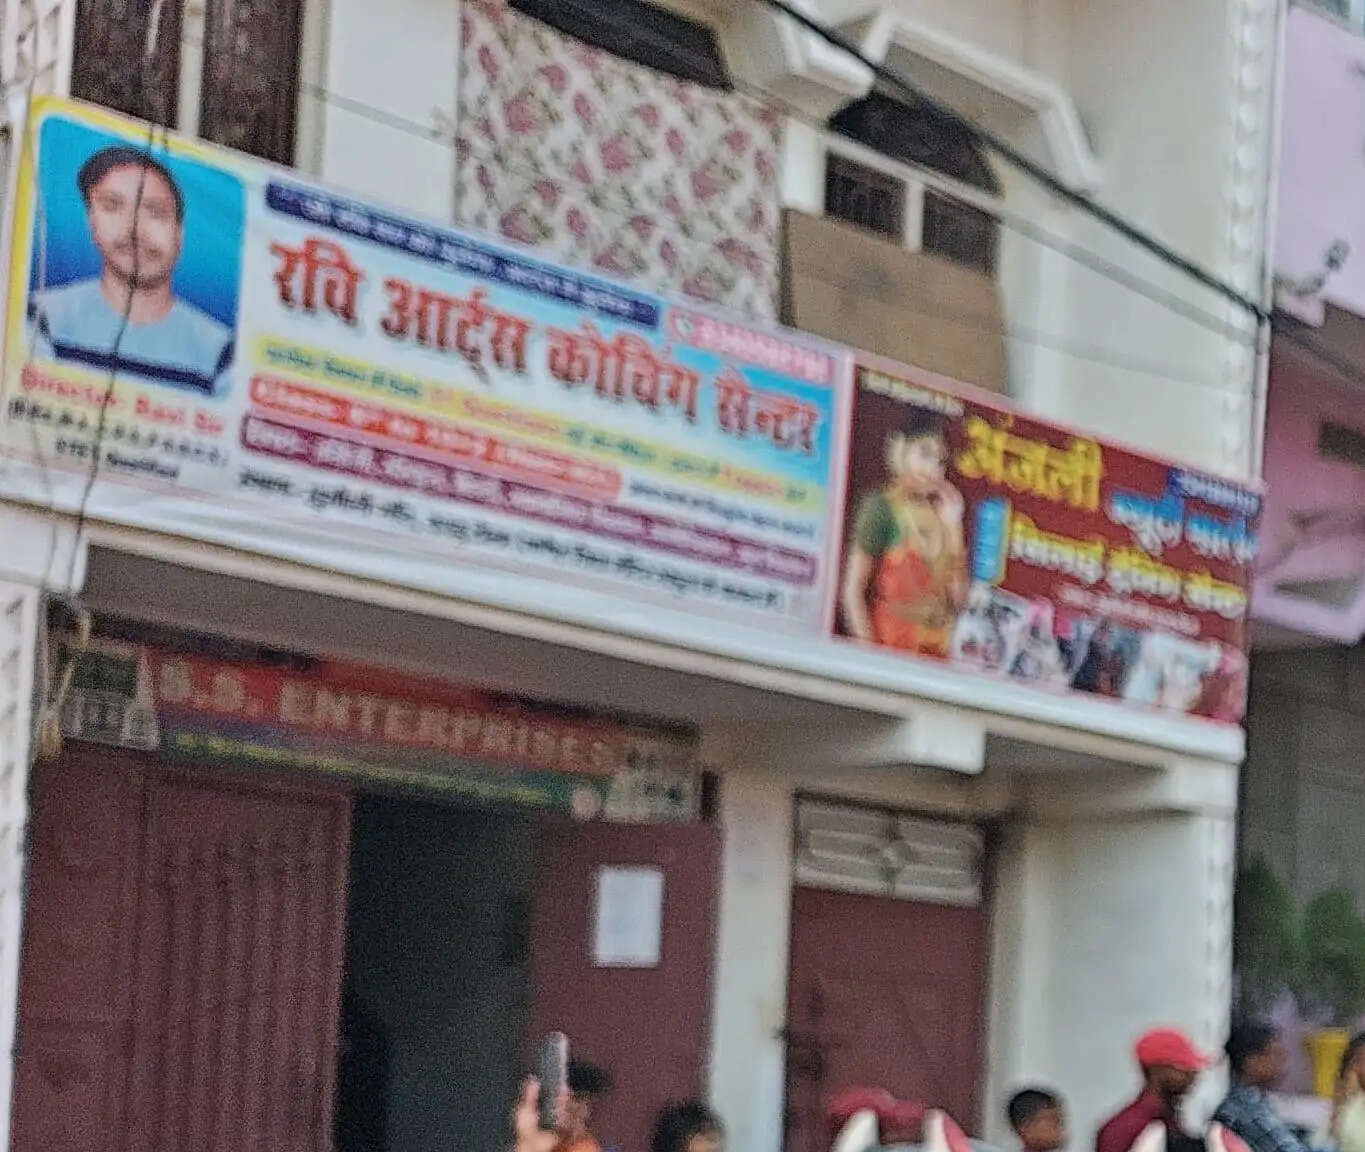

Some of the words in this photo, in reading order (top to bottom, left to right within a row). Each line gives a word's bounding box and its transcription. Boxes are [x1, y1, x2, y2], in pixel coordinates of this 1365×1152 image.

[269, 235, 366, 328] रवि
[953, 412, 1103, 512] अंजली
[279, 679, 620, 770] ENTERPRISES
